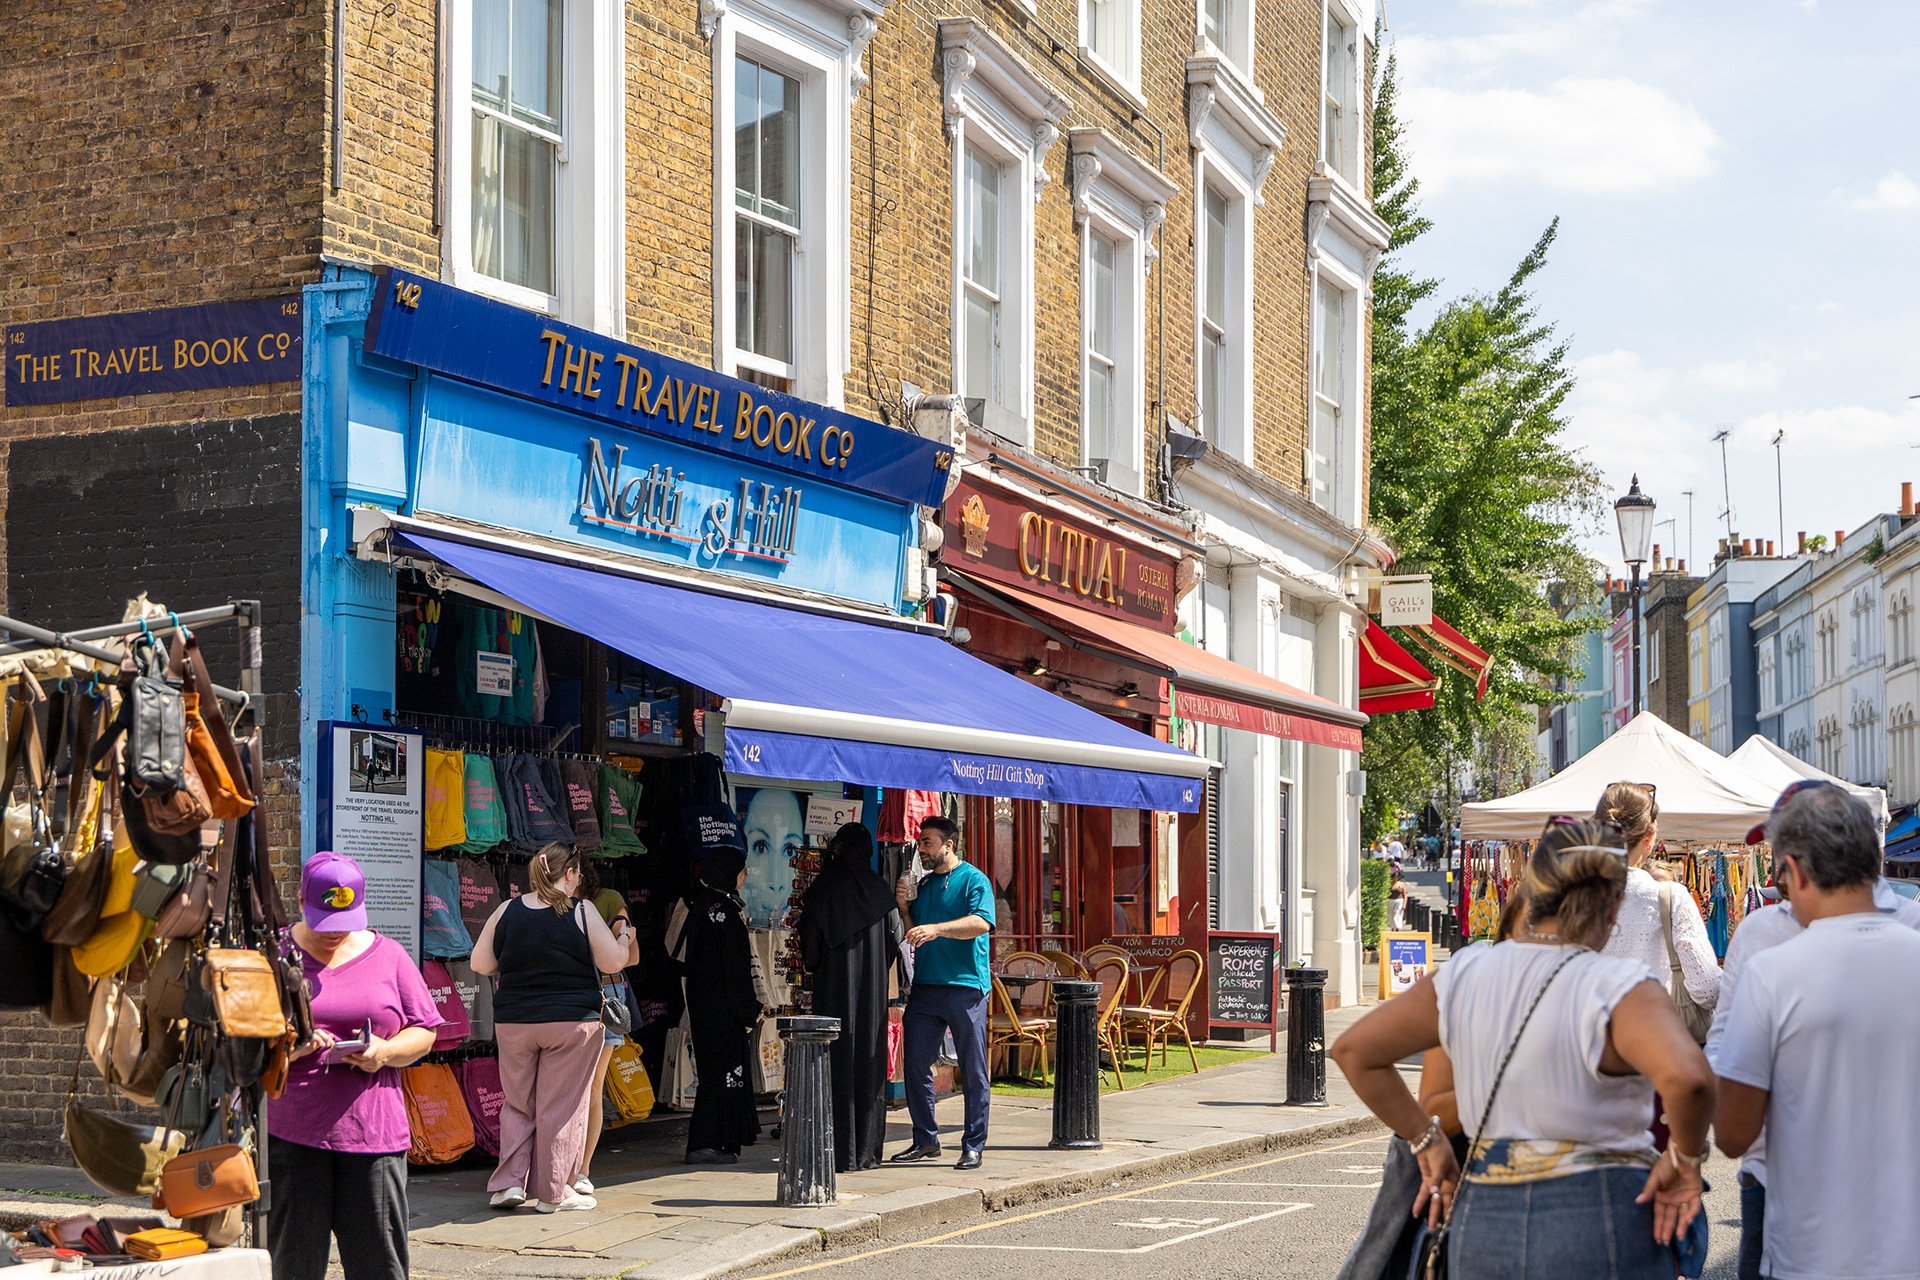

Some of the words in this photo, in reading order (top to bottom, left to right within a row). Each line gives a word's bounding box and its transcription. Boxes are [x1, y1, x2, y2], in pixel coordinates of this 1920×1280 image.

[396, 280, 422, 309] 142
[280, 302, 298, 316] 142
[10, 332, 25, 345] 142
[15, 354, 62, 384] THE
[70, 346, 164, 378] TRAVEL
[174, 336, 250, 370] BOOK
[540, 330, 604, 398] THE
[614, 353, 724, 434] TRAVEL
[733, 391, 816, 460] BOOK
[934, 450, 951, 471] 142
[729, 478, 802, 556] Hill
[1138, 564, 1170, 591] OSTERIA
[1136, 588, 1170, 616] ROMANA
[1388, 596, 1425, 607] GAIL's
[1178, 694, 1209, 715] OSTERIA
[1210, 702, 1240, 723] ROMANA
[743, 744, 760, 762] 142
[952, 759, 985, 785] Notting
[986, 763, 1004, 782] Hill
[1005, 765, 1022, 784] Gift
[1024, 767, 1044, 790] Shop
[567, 782, 579, 790] the
[700, 821, 728, 830] Notting
[701, 829, 735, 837] shopping
[462, 876, 473, 884] the
[424, 894, 442, 904] tting
[1122, 938, 1142, 946] NON
[1151, 937, 1185, 946] ENTRO
[1218, 944, 1269, 957] EXPERIENCE
[1222, 957, 1264, 971] ROME
[1218, 976, 1264, 990] PASSPORT
[1218, 994, 1247, 1002] Authentic
[1251, 1012, 1268, 1021] WAY
[617, 1061, 635, 1069] otting
[480, 1091, 505, 1103] Notting
[483, 1109, 498, 1117] bag.
